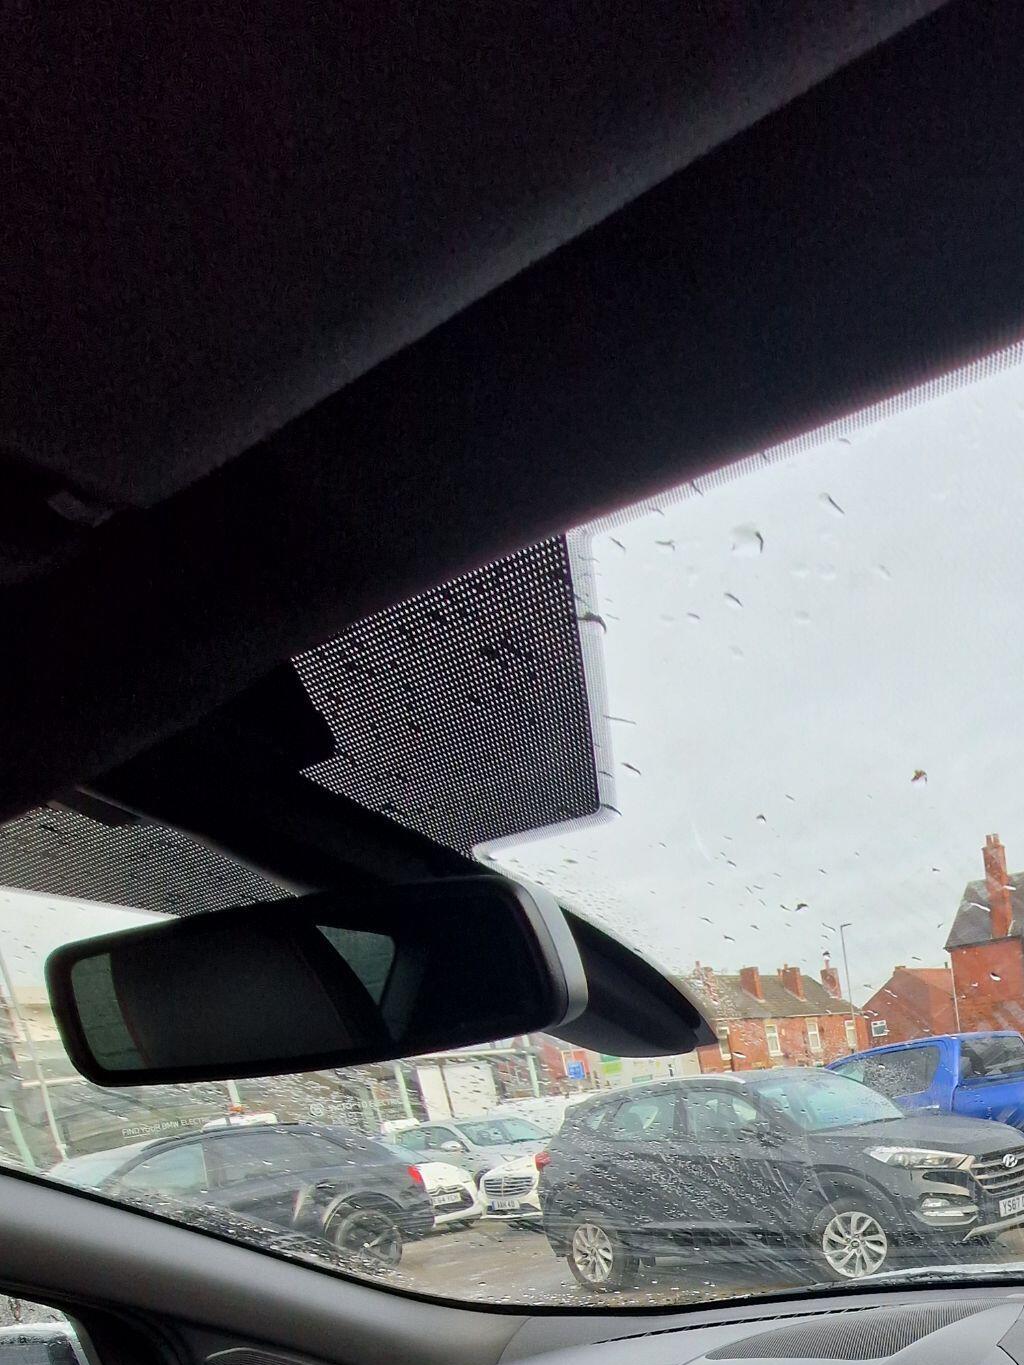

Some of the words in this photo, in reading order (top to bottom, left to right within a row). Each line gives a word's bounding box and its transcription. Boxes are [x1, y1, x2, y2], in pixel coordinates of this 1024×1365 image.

[122, 1127, 140, 1137] FIND
[141, 1124, 161, 1134] YOUR
[161, 1121, 179, 1131] BMW
[1003, 1197, 1020, 1214] YS67
